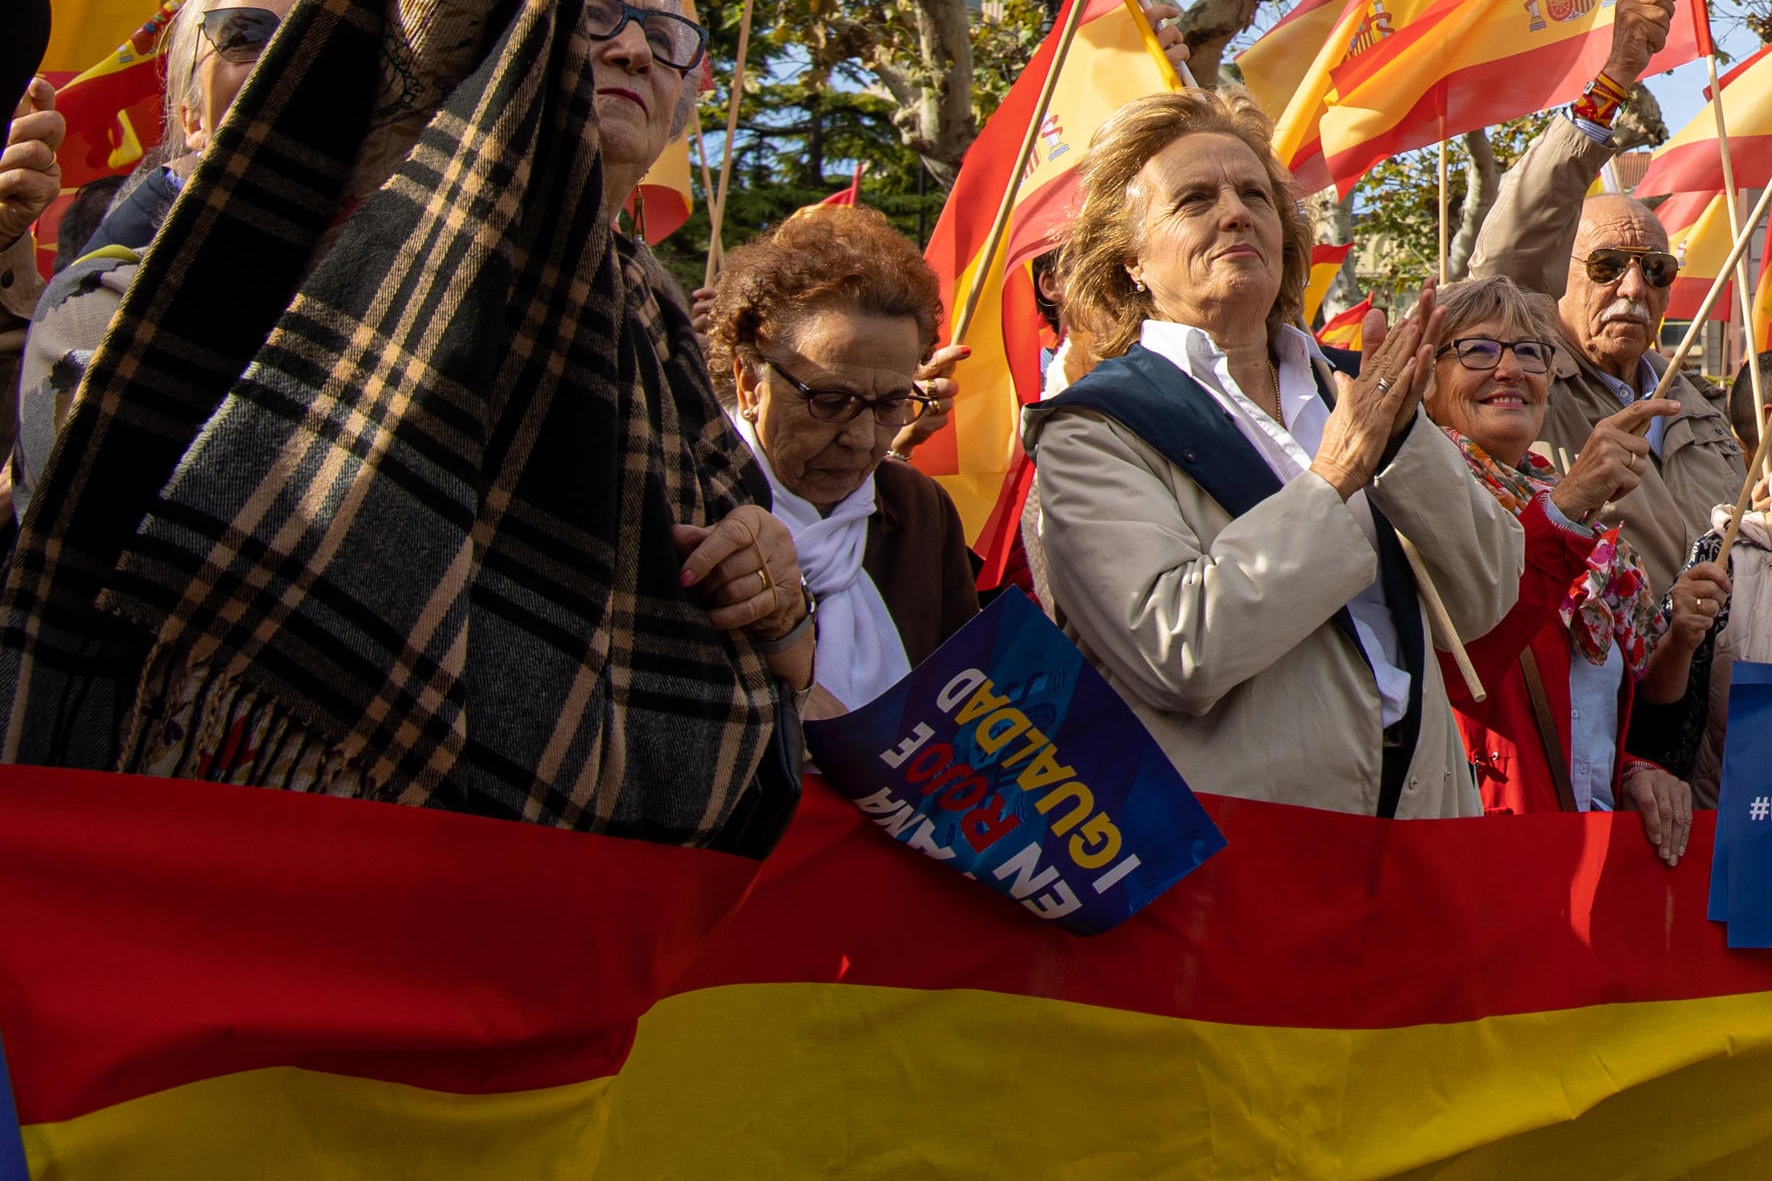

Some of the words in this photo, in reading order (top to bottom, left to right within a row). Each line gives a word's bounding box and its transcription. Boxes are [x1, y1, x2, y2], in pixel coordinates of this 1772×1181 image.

[879, 721, 935, 769] E
[935, 667, 1142, 895] IGUALDAD
[905, 741, 1021, 854] ROJO
[992, 841, 1083, 920] EN
